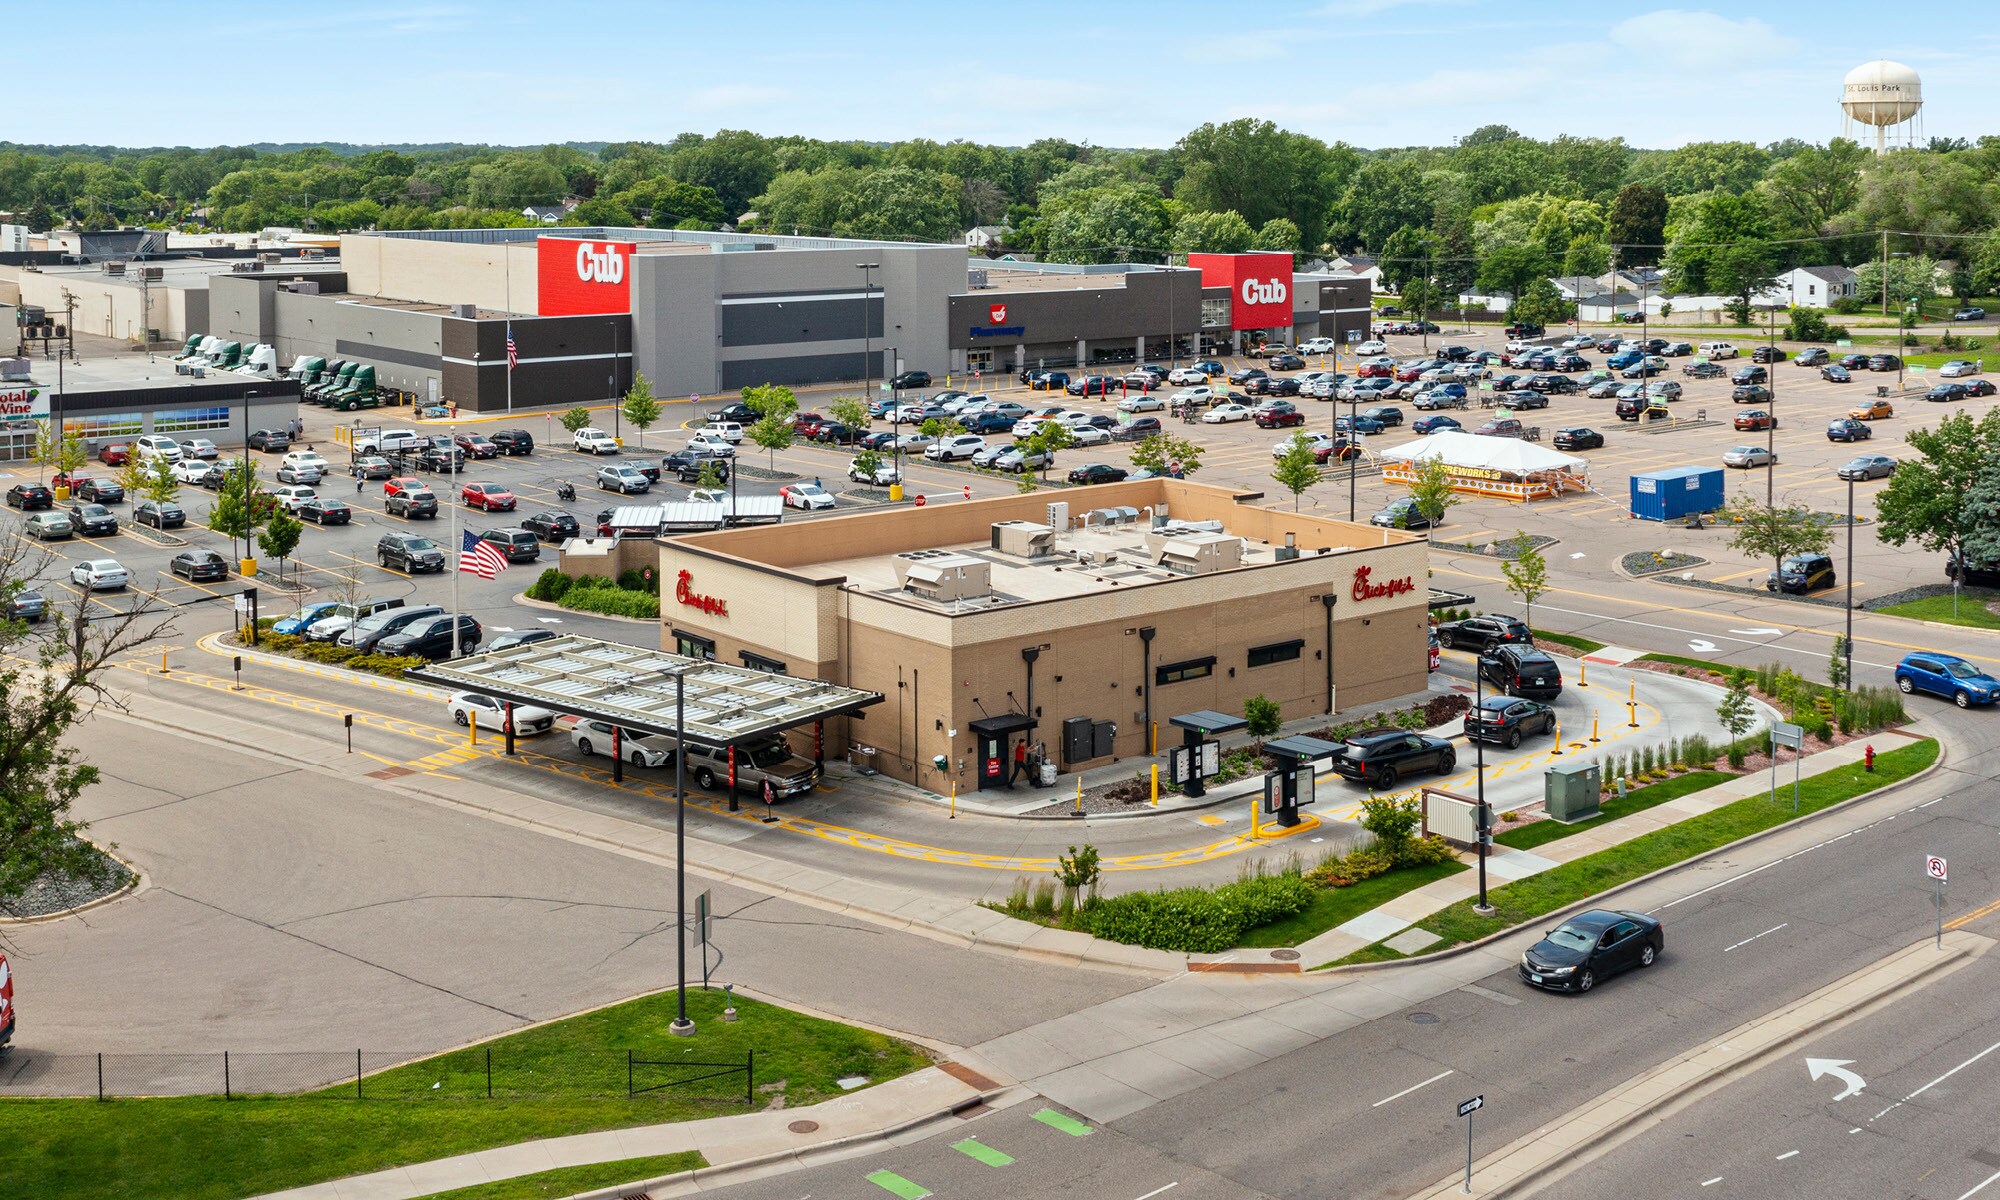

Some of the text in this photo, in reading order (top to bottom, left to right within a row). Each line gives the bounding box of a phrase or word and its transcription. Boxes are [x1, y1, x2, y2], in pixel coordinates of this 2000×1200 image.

[577, 243, 624, 284] Cub
[1242, 278, 1287, 305] Cub
[970, 326, 1025, 337] Pharmacy
[0, 389, 26, 403] otal
